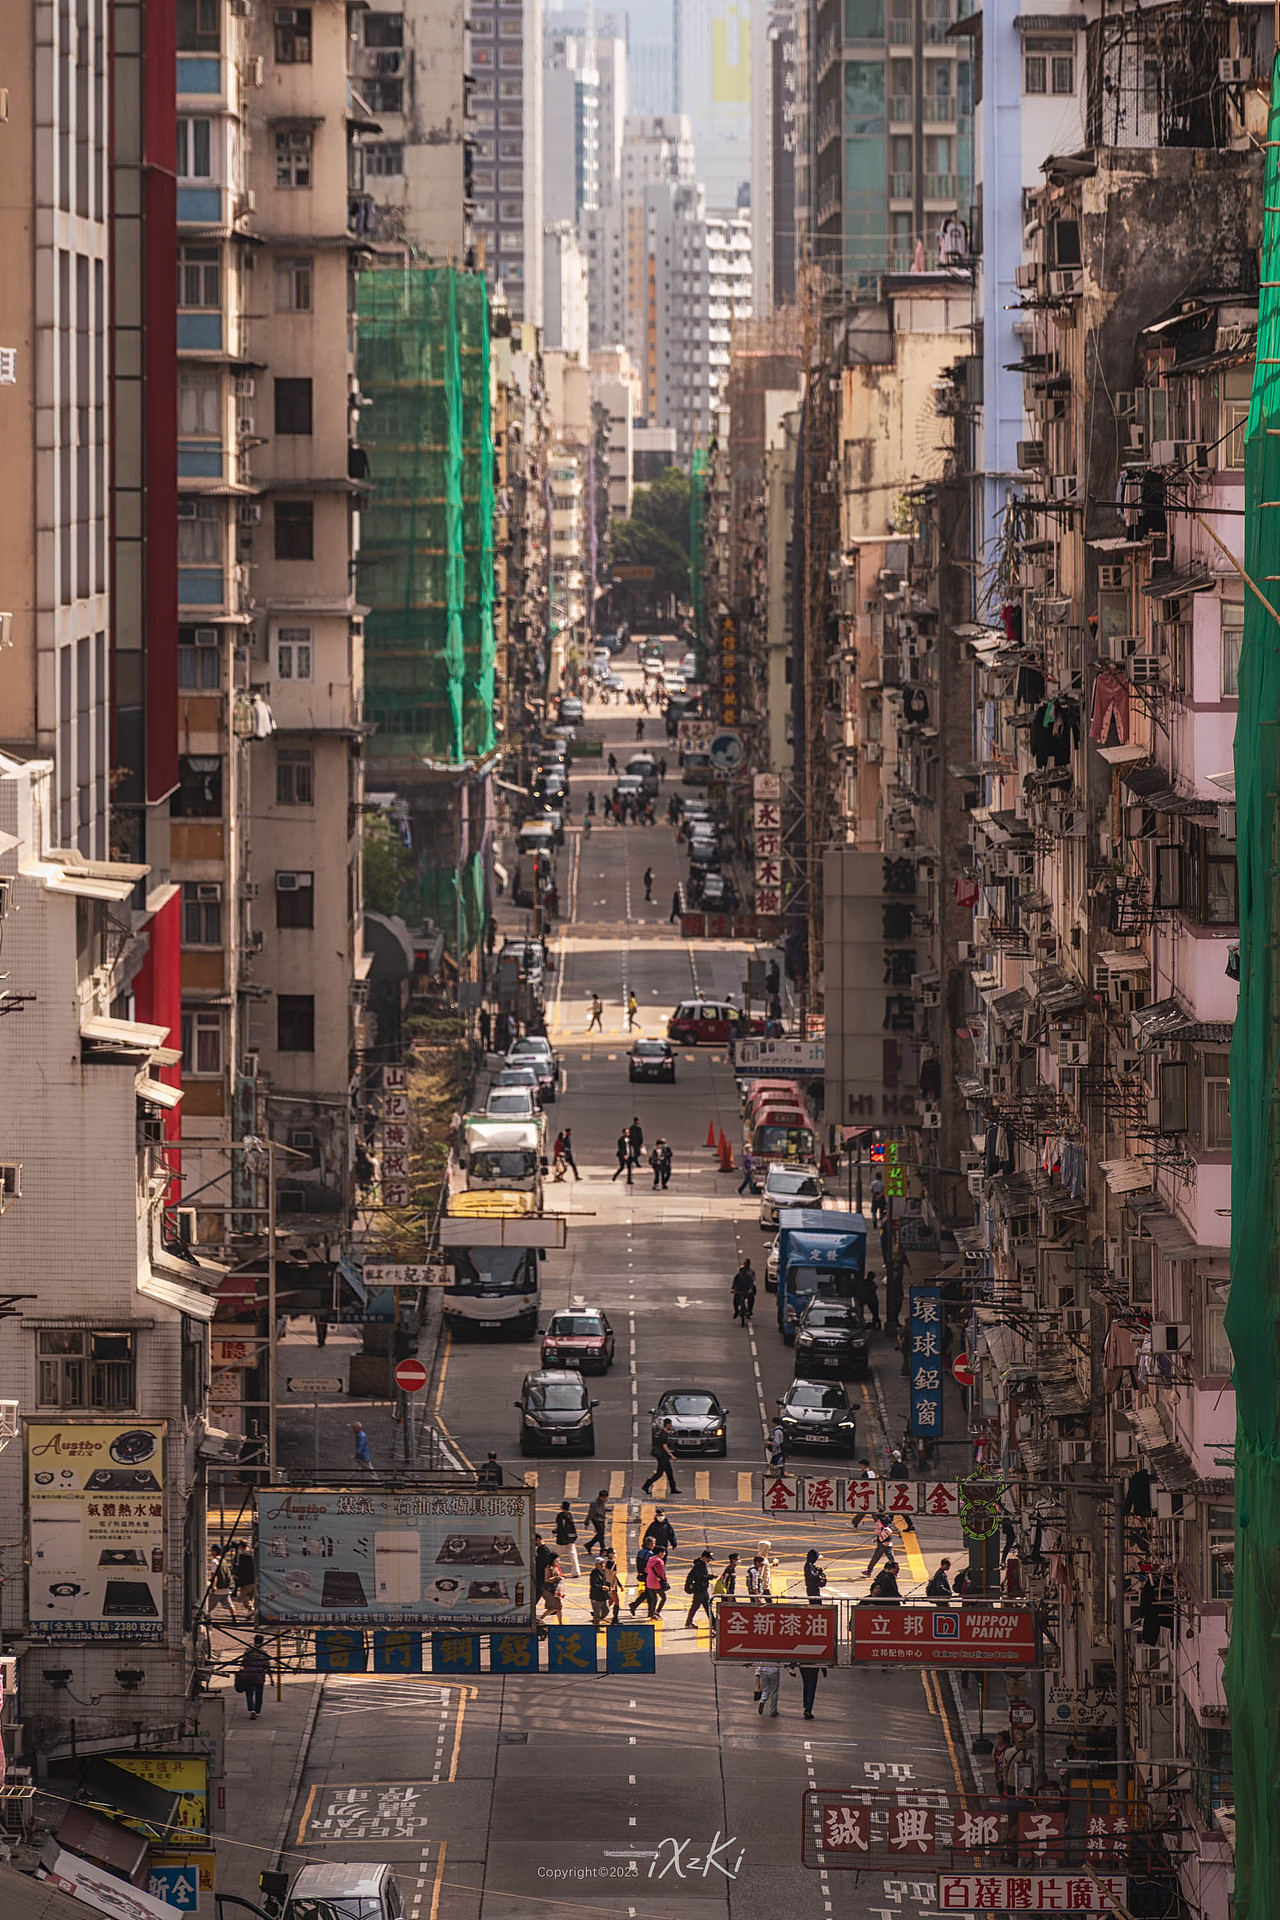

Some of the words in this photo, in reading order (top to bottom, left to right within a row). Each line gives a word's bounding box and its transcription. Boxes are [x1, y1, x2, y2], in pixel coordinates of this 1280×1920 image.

[384, 1070, 406, 1204] 山記機械行
[913, 1296, 940, 1426] 環球鋁窗
[31, 1433, 103, 1456] Austbo
[336, 1495, 526, 1517] 煤氣、石油氣爐具批發
[765, 1479, 957, 1514] 金源行五金
[87, 1503, 162, 1517] 氣體熱水爐
[267, 1496, 327, 1520] Austbo
[140, 1622, 163, 1632] 8276
[727, 1612, 828, 1637] 全新漆油
[871, 1615, 924, 1636] 立邦
[966, 1615, 1019, 1627] NIPPON
[972, 1627, 1012, 1639] PAINT
[872, 1649, 922, 1658] 立邦配色中心
[133, 1772, 172, 1780] 有限公司
[311, 1816, 428, 1829] CLEAR
[320, 1827, 415, 1838] KEEP
[826, 1807, 1059, 1857] 誠興椰子
[943, 1876, 1123, 1909] 百達膠片廣告
